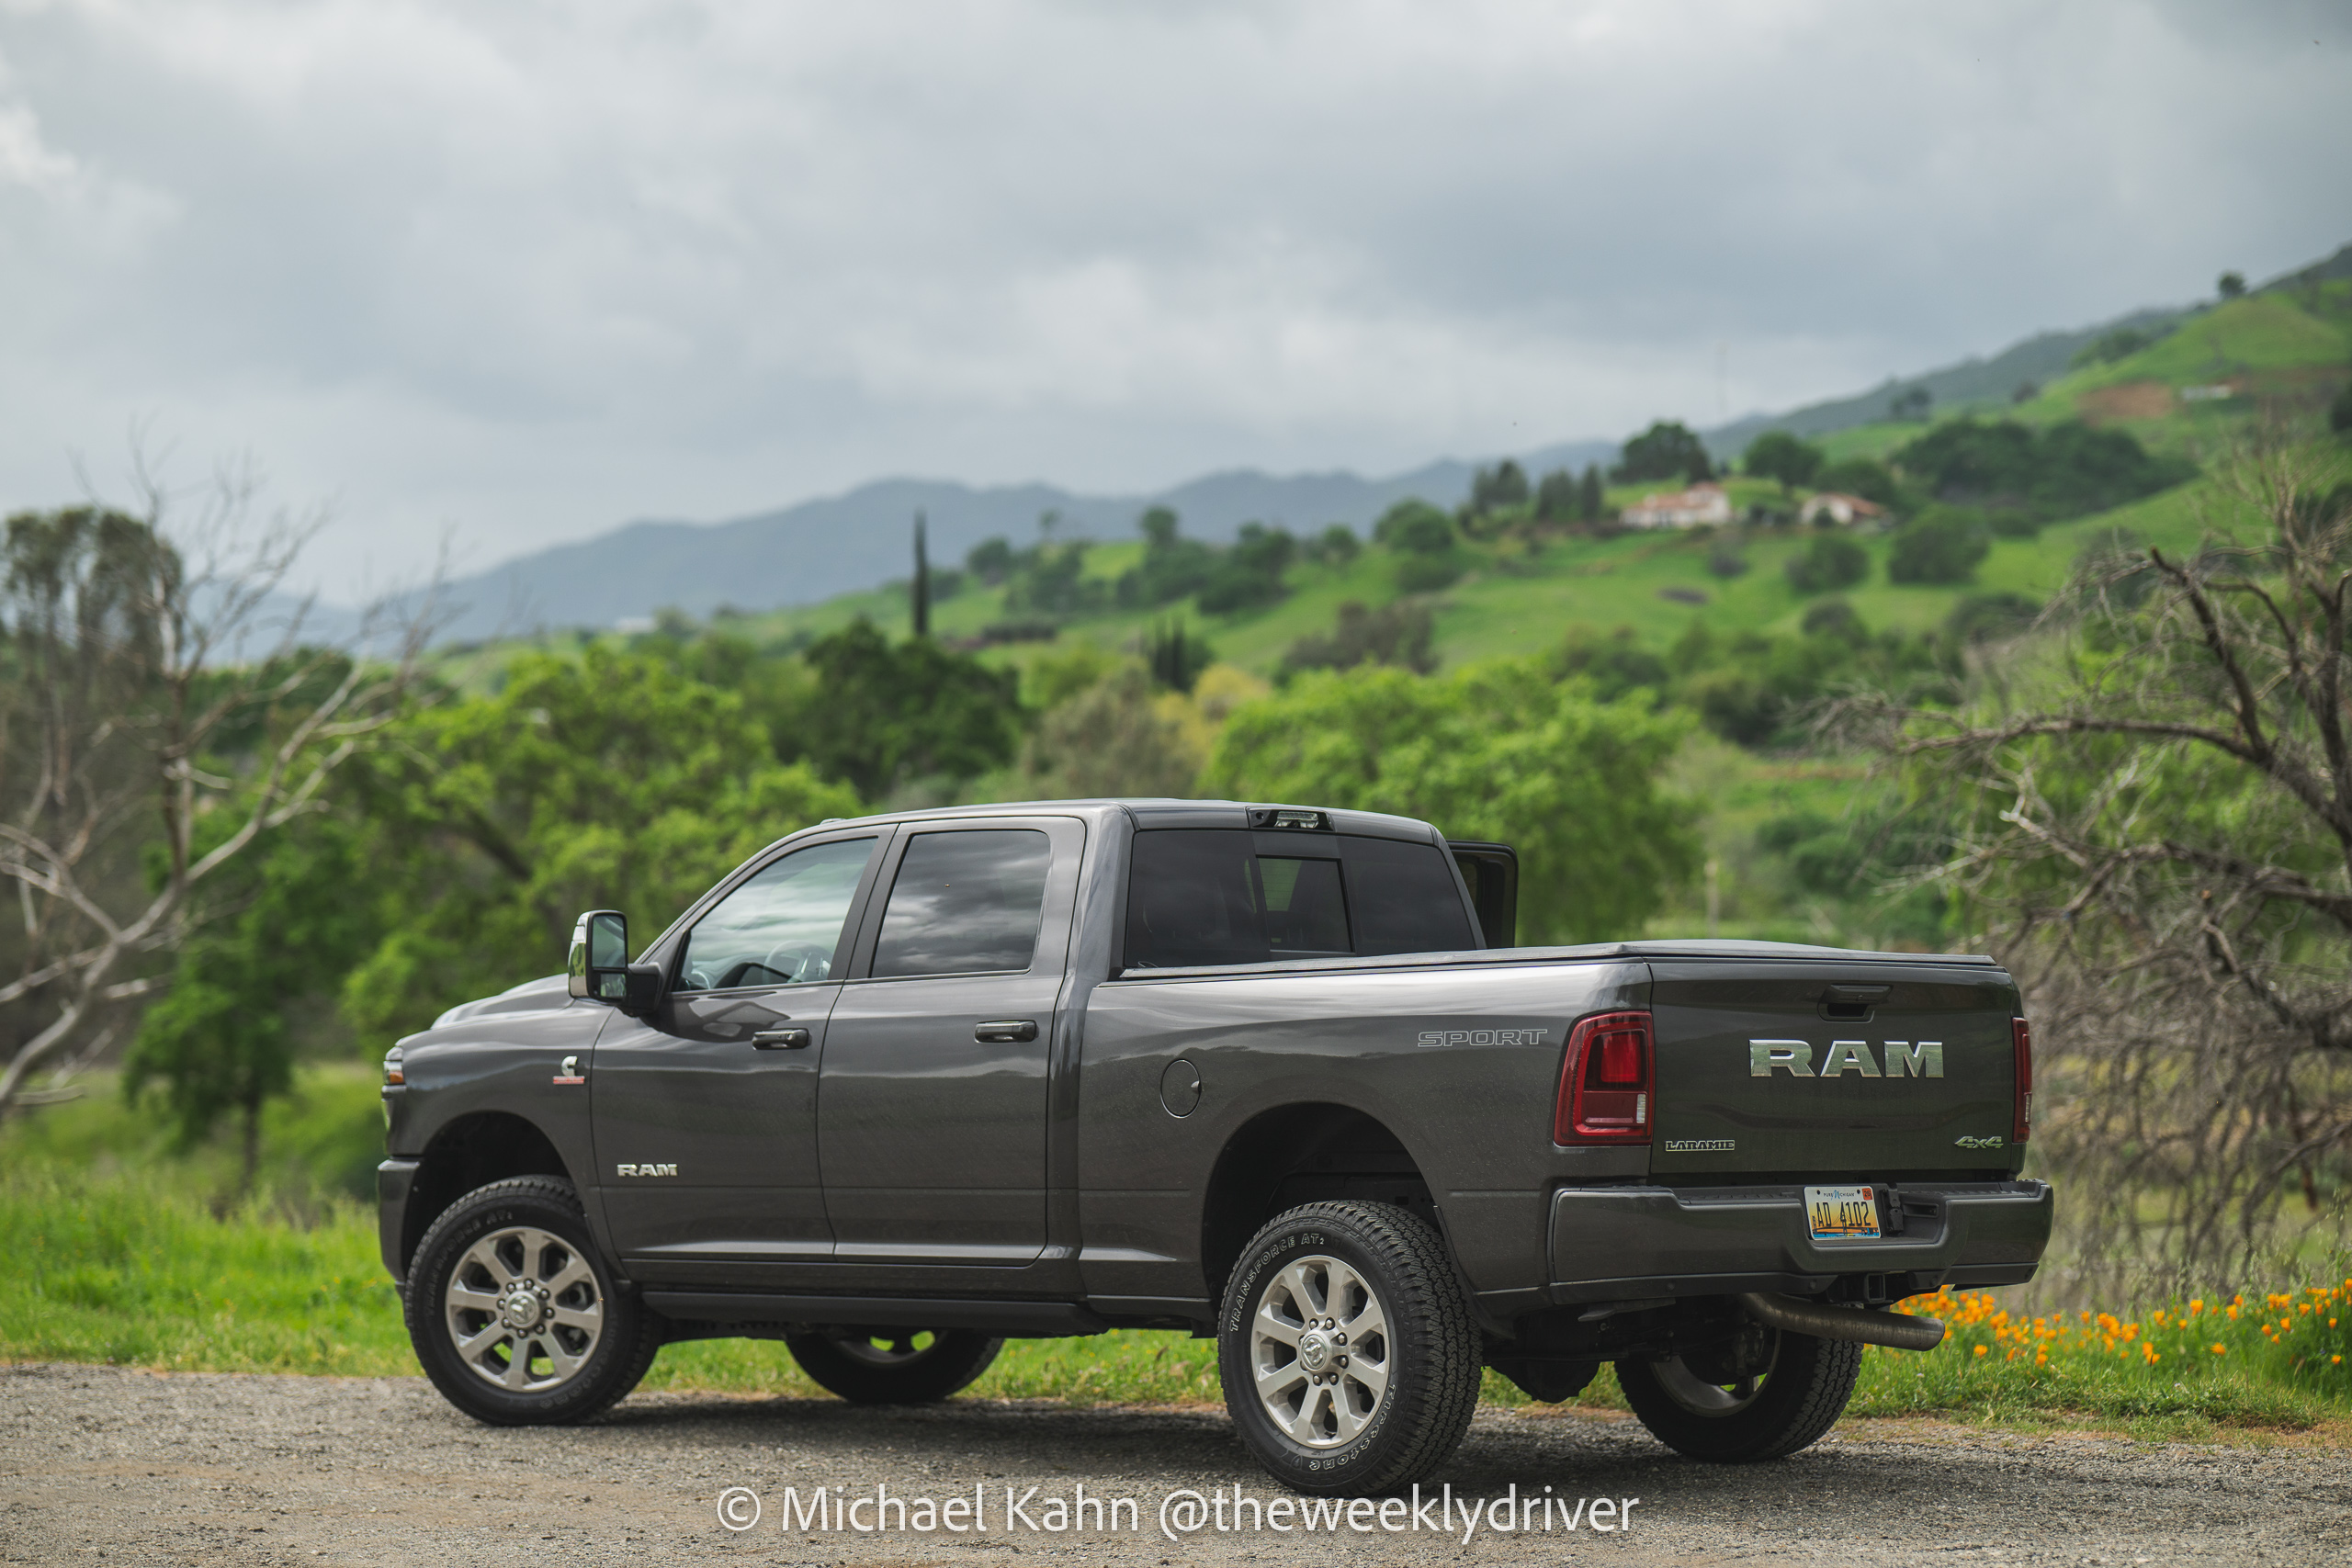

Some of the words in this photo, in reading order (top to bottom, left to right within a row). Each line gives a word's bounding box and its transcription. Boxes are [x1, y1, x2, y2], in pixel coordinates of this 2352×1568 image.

[1418, 1029, 1548, 1047] SPORT
[1749, 1039, 1944, 1077] RAM
[1666, 1140, 1735, 1152] LARAMIE
[1954, 1135, 2004, 1148] 4x4
[616, 1164, 678, 1177] RAM
[1816, 1201, 1831, 1227] AD
[1840, 1201, 1871, 1227] 4102
[1229, 1235, 1295, 1332] TRANSFORCE
[1309, 1384, 1396, 1471] Firestone
